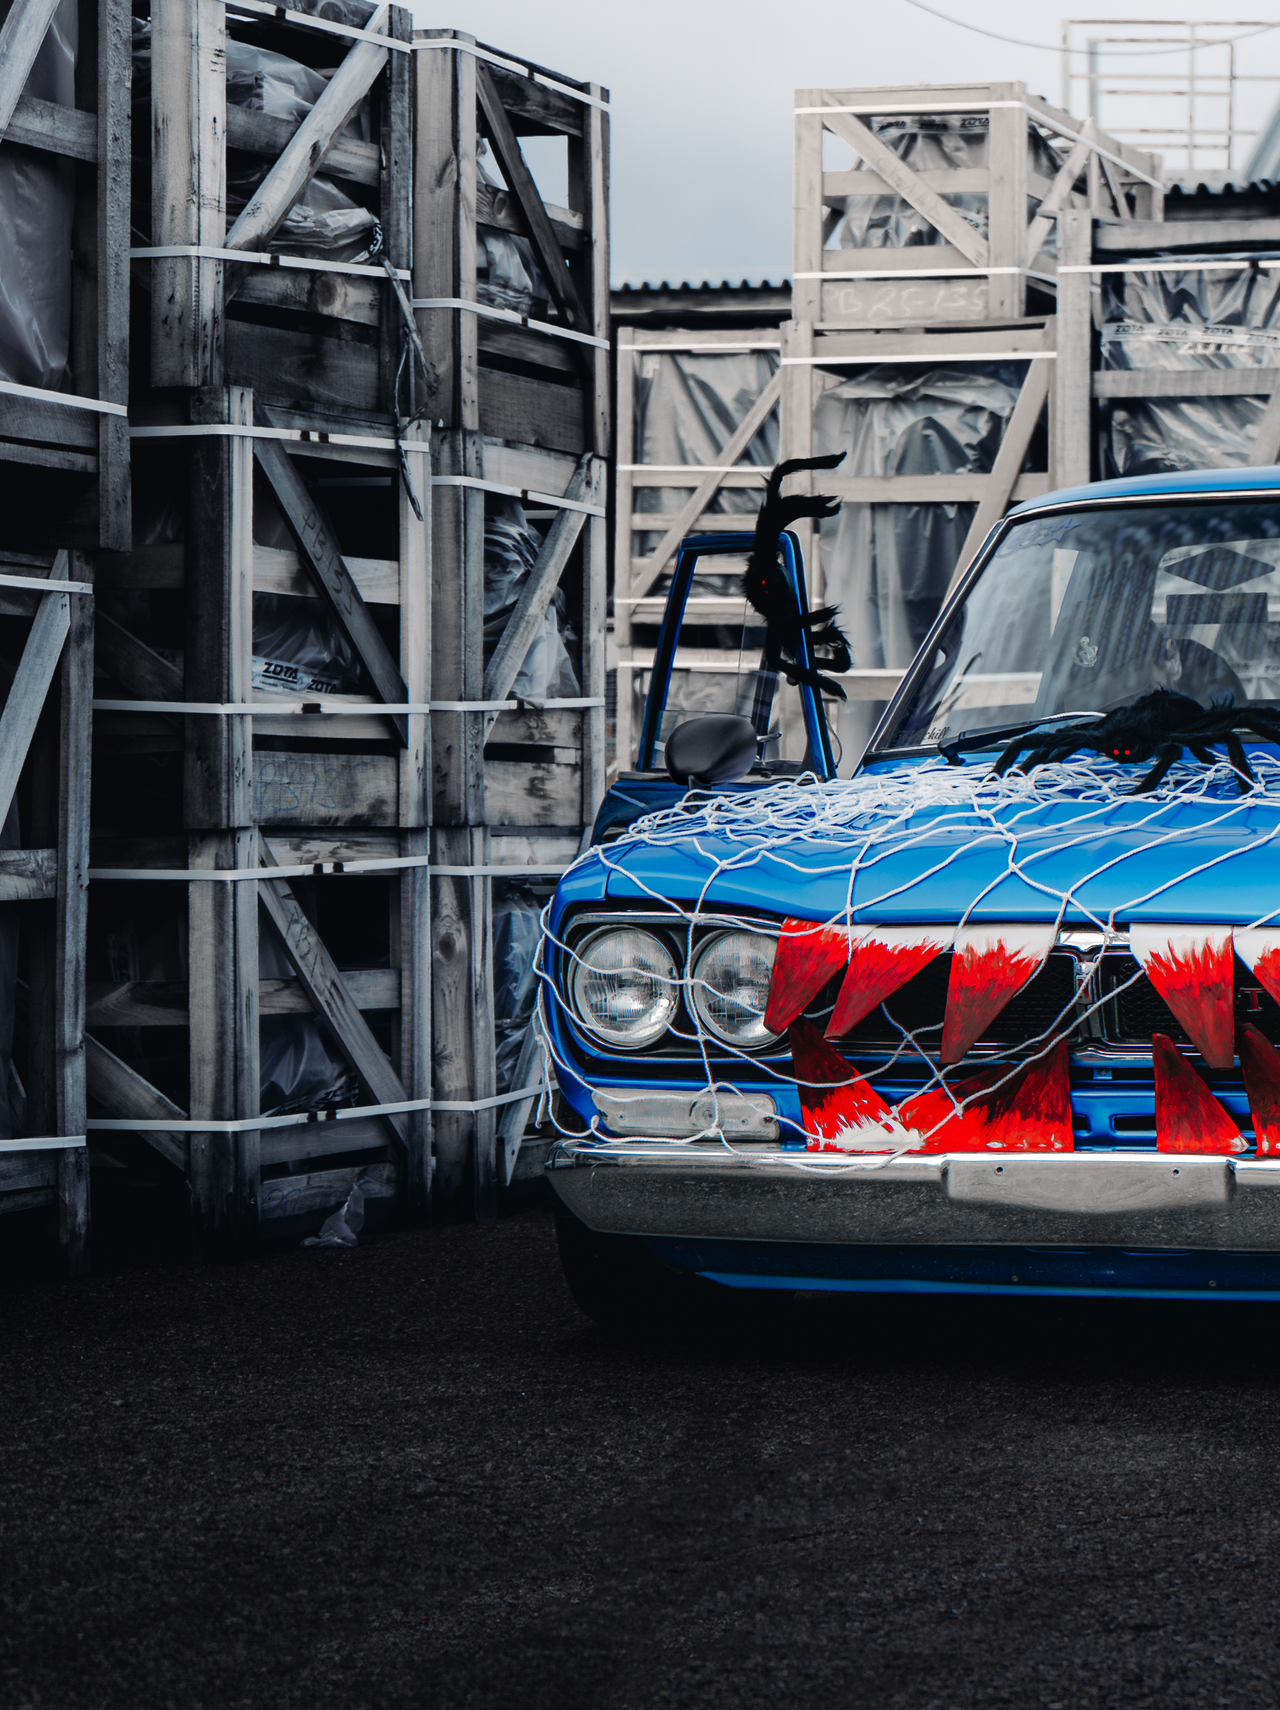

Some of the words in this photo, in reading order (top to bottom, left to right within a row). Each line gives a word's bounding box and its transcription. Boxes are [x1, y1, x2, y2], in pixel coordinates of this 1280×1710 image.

[1115, 324, 1145, 334] ZOTA
[1202, 326, 1234, 336] ZOTA
[262, 661, 299, 680] ZOTA
[307, 679, 337, 694] ZOTA
